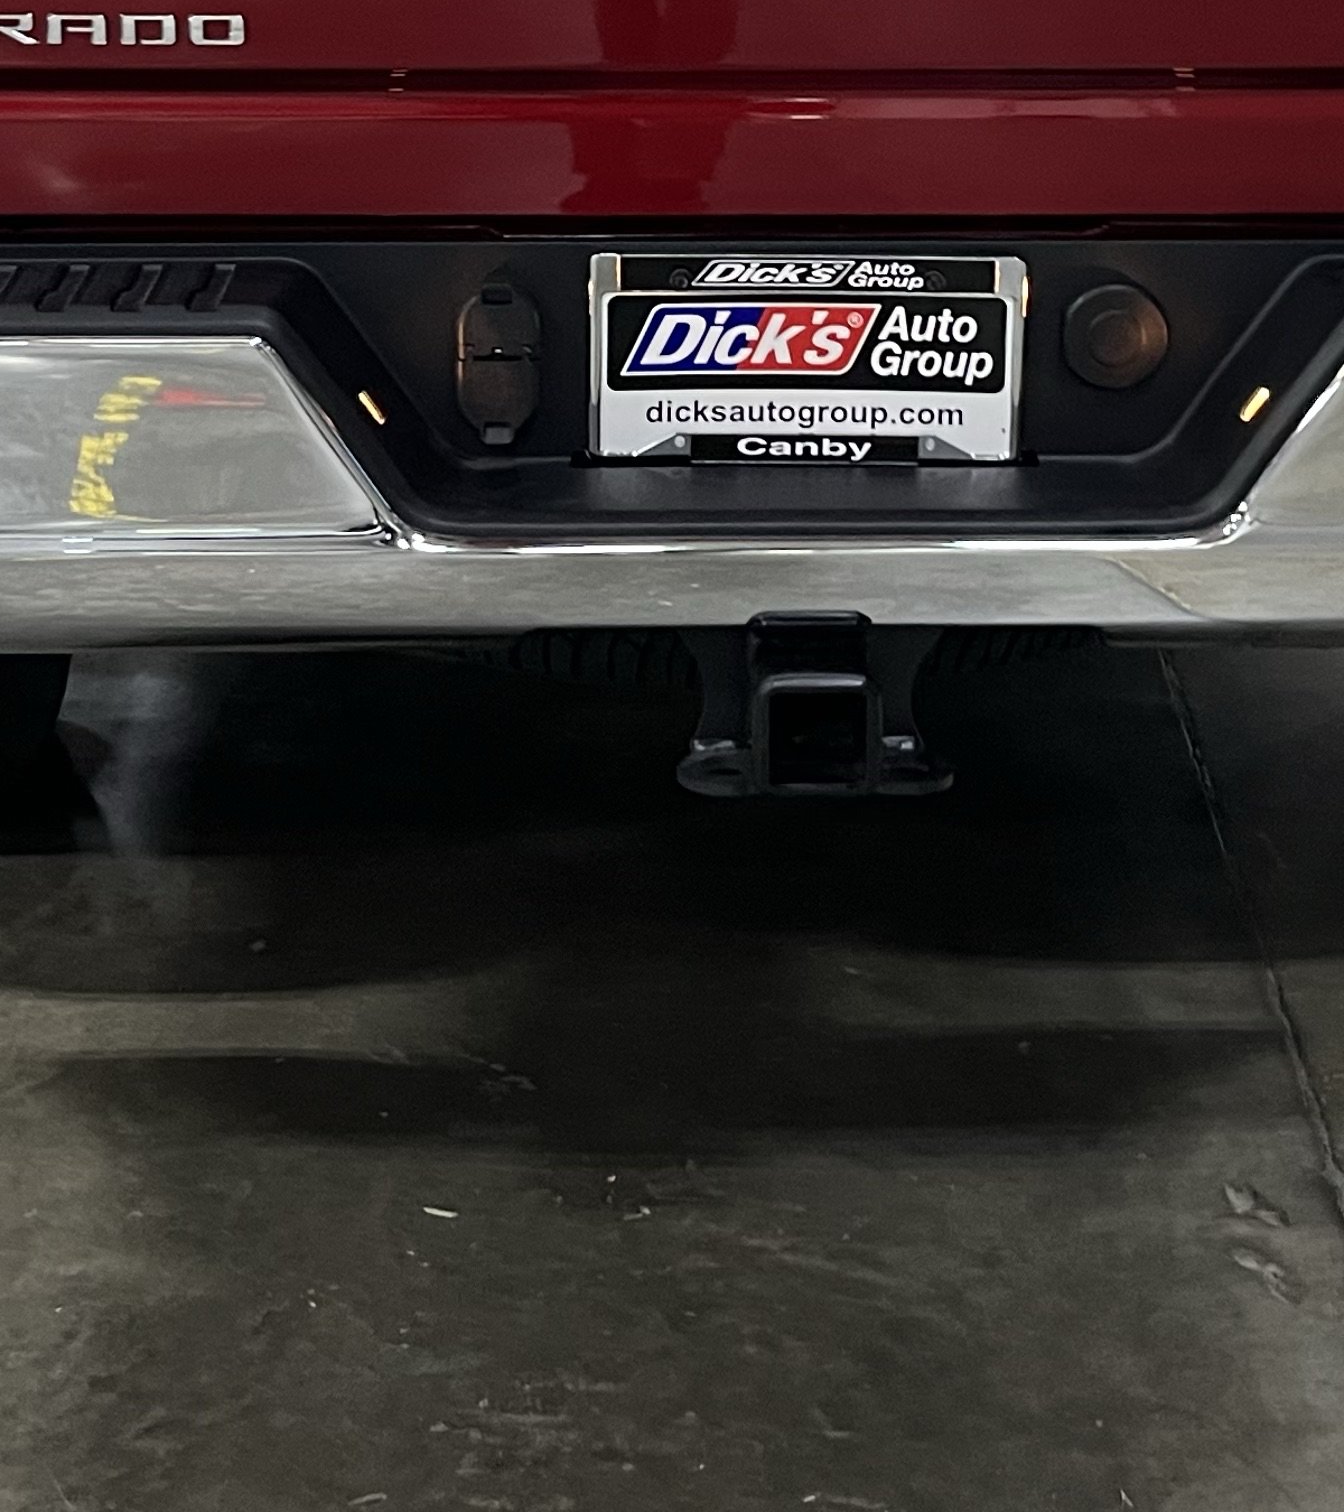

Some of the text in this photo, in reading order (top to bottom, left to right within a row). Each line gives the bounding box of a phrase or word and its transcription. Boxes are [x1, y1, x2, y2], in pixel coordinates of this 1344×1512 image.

[703, 261, 916, 285] Dick's Auto
[848, 275, 925, 290] Group
[639, 306, 978, 367] Dick's Auto
[869, 342, 995, 386] Group
[645, 399, 964, 429] dicksautogroup.com
[736, 436, 873, 462] Canby
